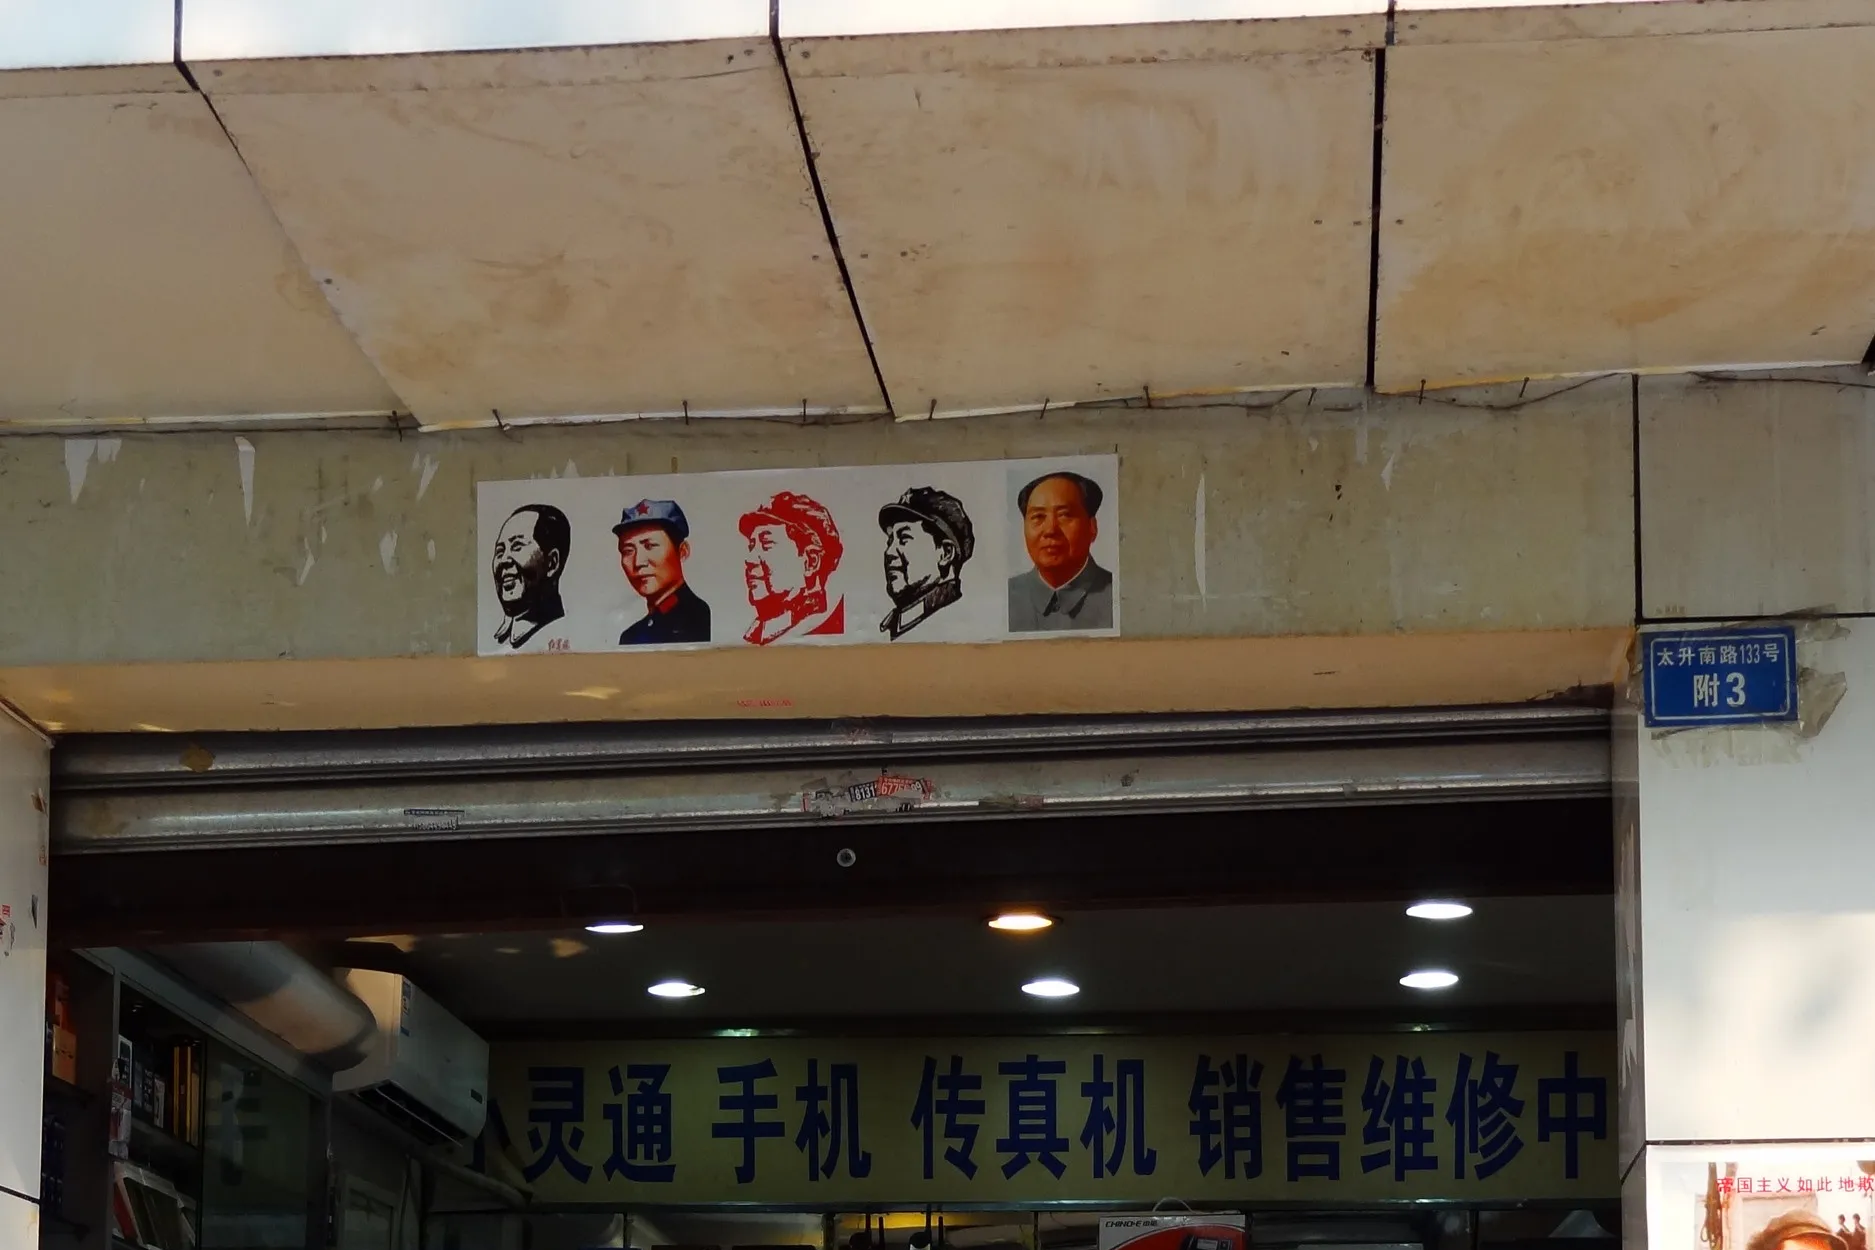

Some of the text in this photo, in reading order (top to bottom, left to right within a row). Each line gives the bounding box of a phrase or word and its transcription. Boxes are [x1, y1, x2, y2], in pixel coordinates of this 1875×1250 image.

[1657, 643, 1779, 667] 太升南路133号
[1693, 672, 1746, 707] 附3
[523, 1051, 1607, 1184] 灵通 手机 传真机 销售维修中
